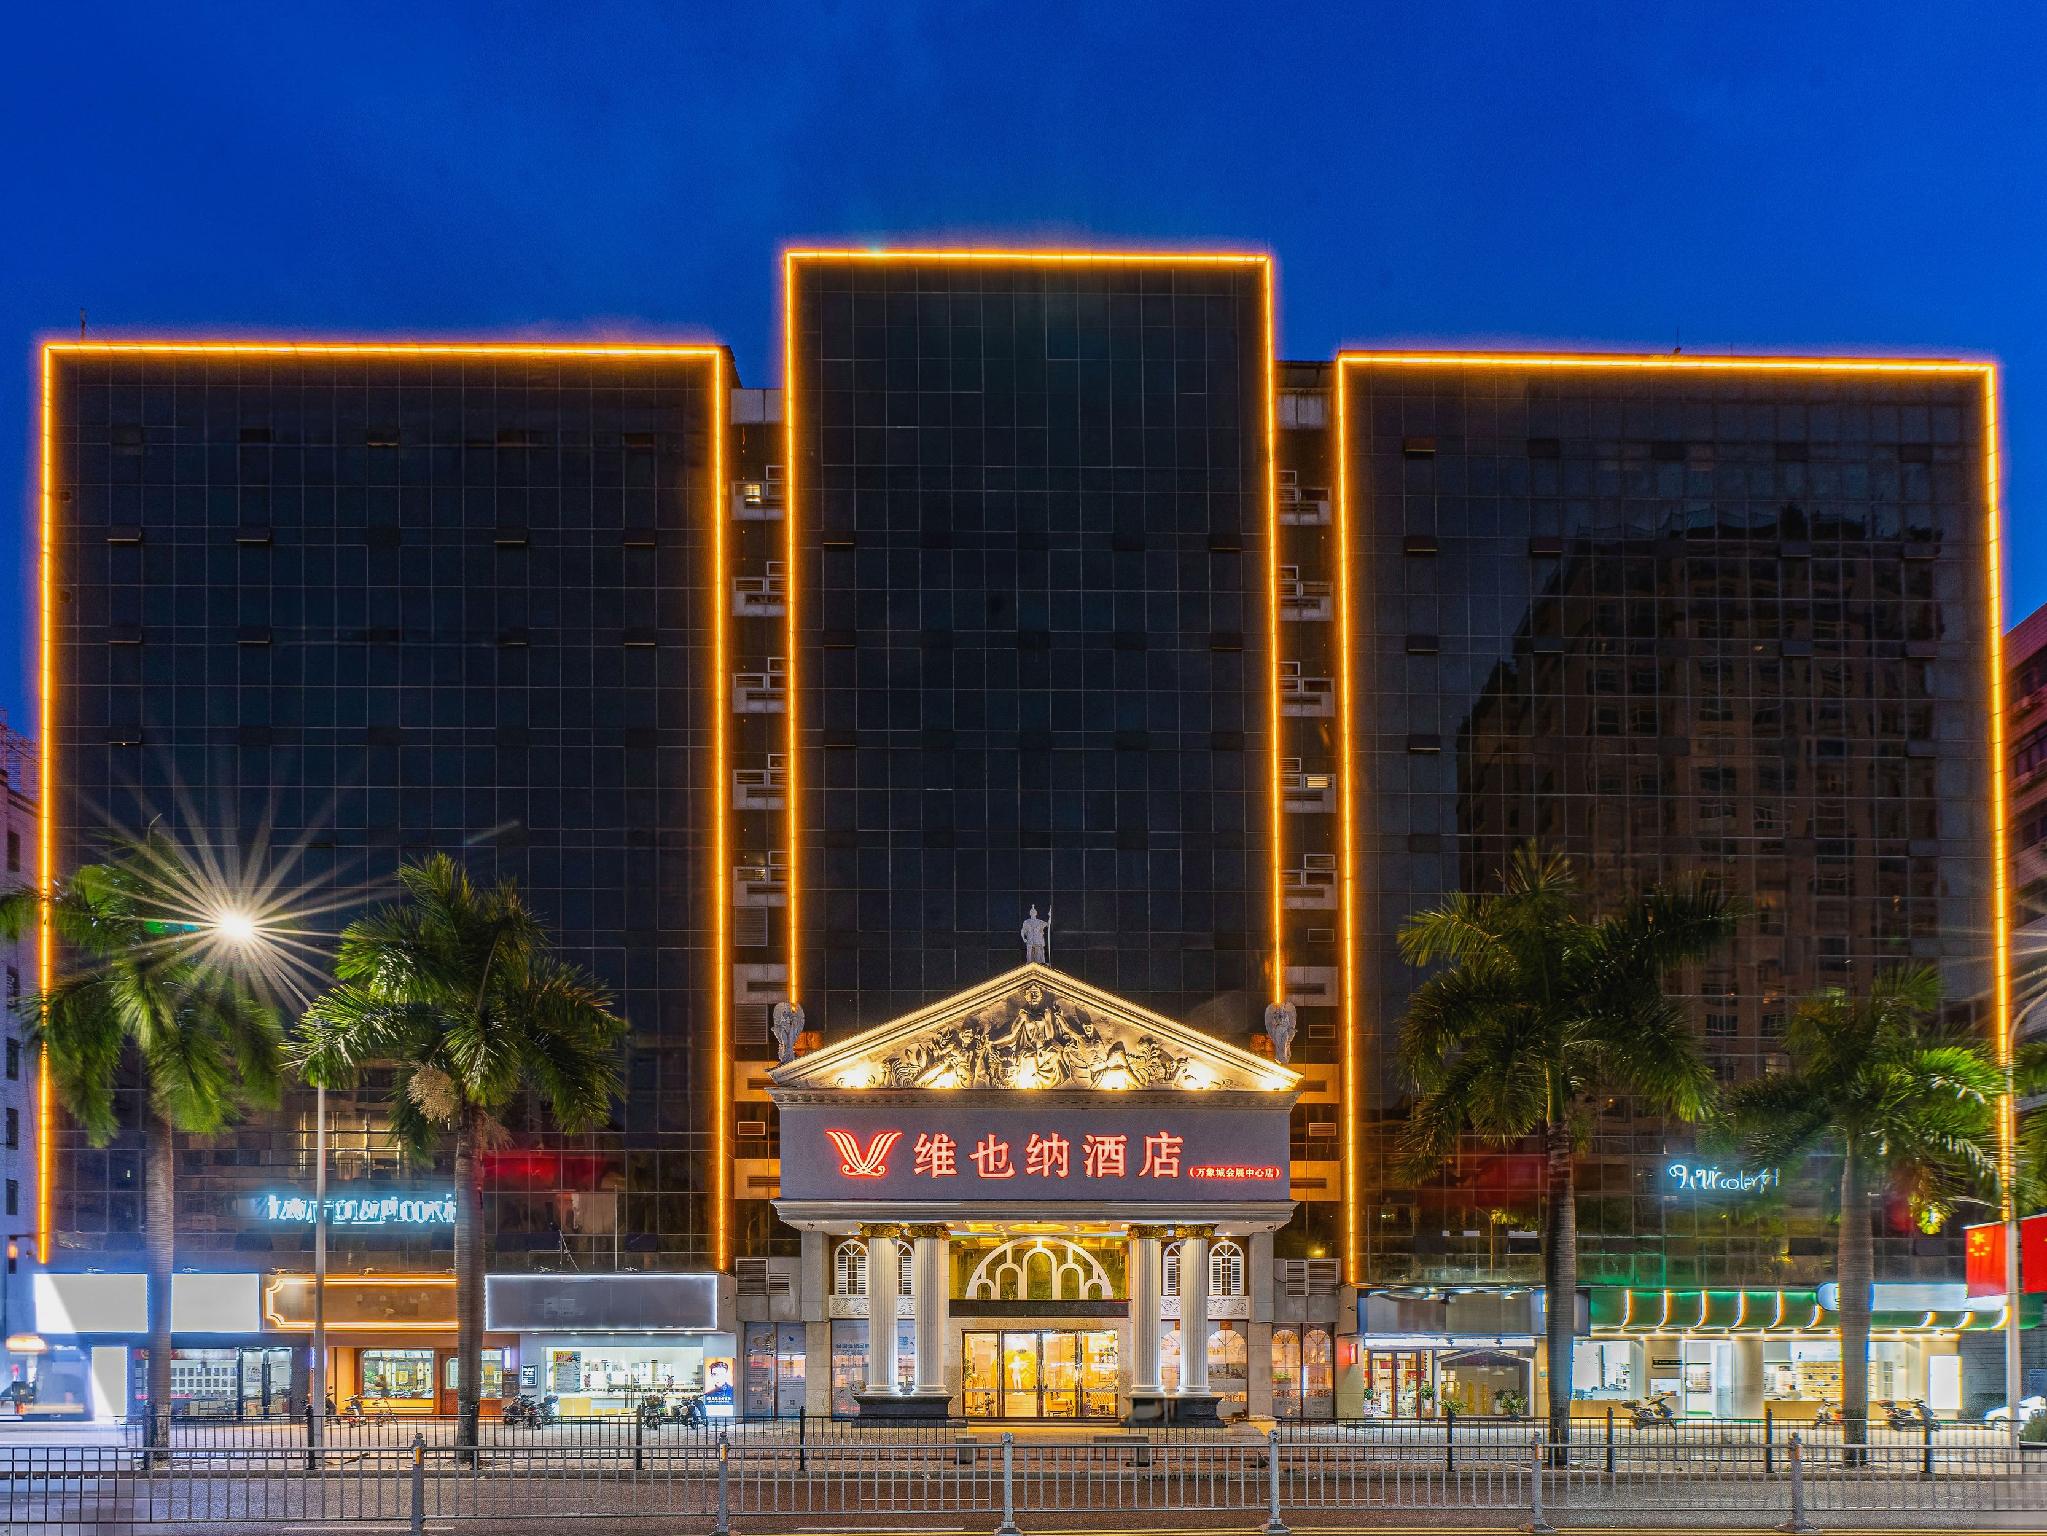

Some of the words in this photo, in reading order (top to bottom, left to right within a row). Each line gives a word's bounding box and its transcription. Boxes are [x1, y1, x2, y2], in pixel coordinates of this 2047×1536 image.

[913, 1131, 1184, 1179] 维也纳酒店
